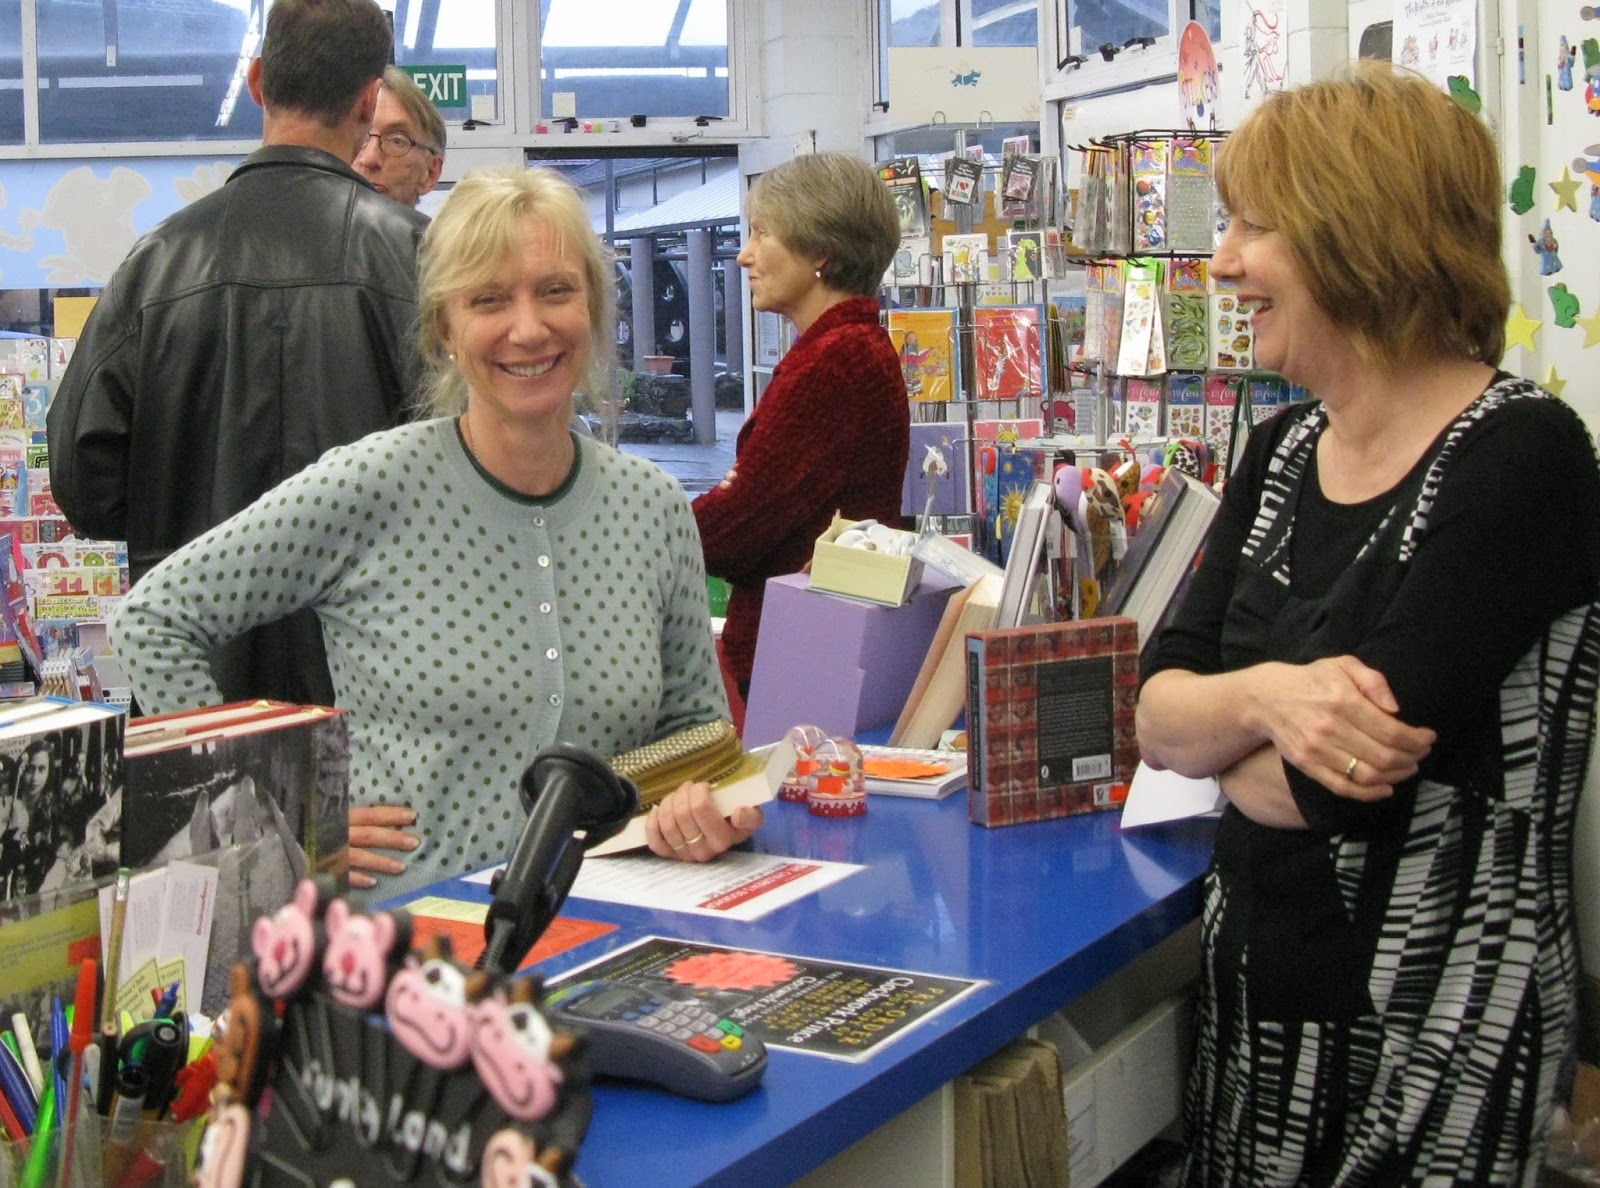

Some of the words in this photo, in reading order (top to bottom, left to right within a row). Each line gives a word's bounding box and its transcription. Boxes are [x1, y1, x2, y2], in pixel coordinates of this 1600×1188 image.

[413, 72, 463, 101] EXIT
[828, 976, 915, 1018] Clockwork
[785, 1016, 847, 1044] Prince
[836, 986, 946, 1045] PRE-ORDER
